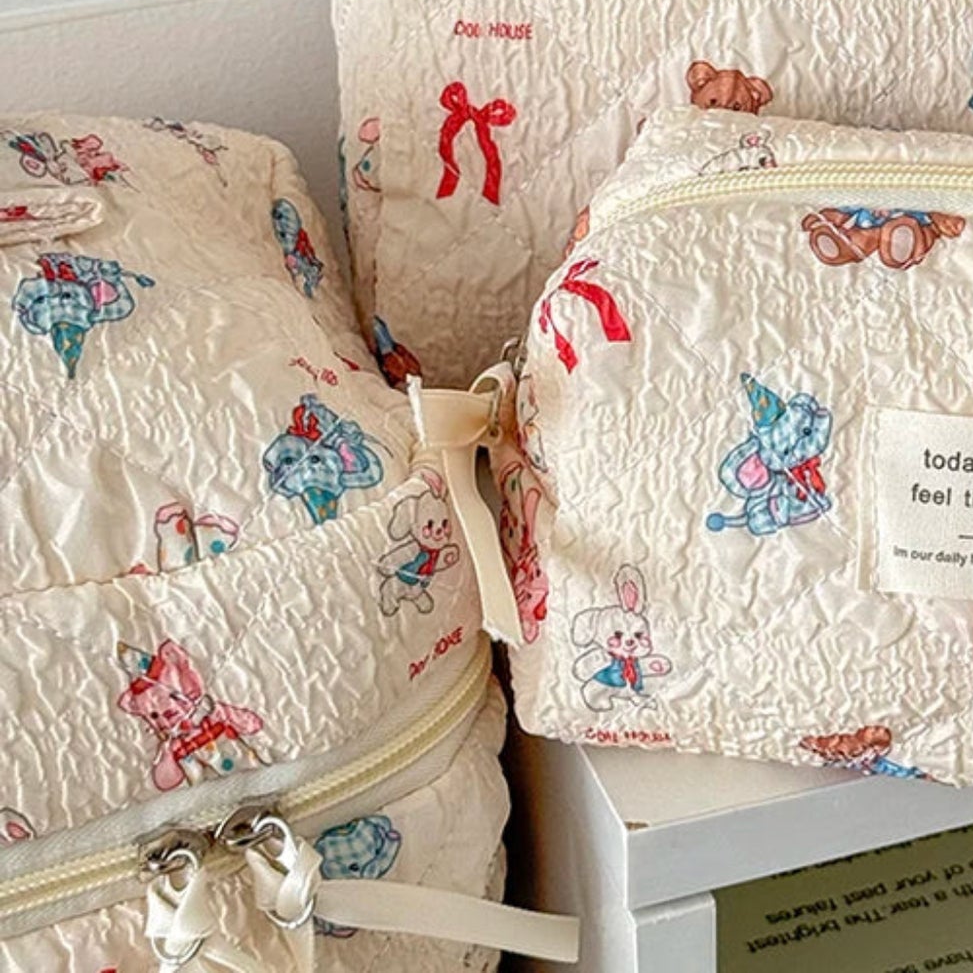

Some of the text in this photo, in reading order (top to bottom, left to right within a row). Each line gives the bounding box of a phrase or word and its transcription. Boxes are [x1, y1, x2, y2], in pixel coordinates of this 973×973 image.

[912, 483, 953, 506] feel
[910, 550, 934, 561] our
[894, 869, 937, 891] your
[942, 864, 964, 881] of
[842, 882, 887, 906] past
[933, 890, 948, 901] a
[746, 919, 841, 953] brightest
